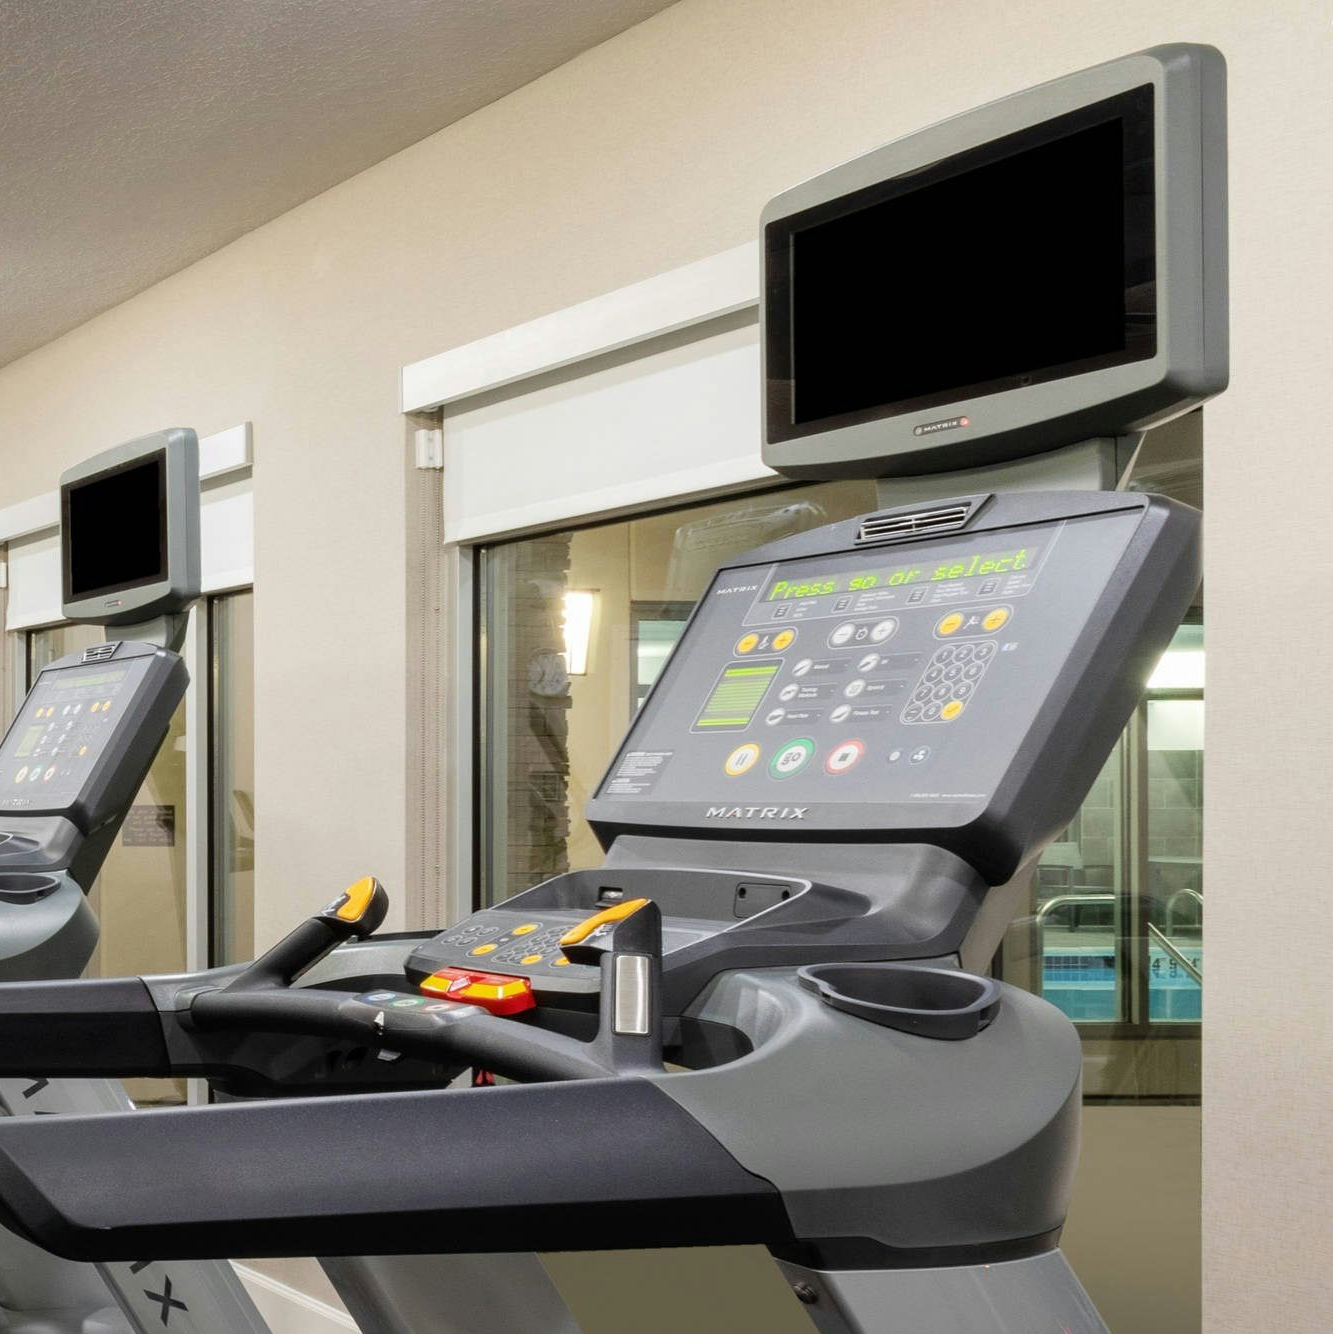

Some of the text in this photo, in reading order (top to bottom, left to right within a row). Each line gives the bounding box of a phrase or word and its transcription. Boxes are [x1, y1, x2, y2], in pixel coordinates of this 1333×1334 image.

[769, 549, 1028, 600] Press go or select
[717, 585, 758, 595] MATRIX
[781, 752, 801, 765] go
[705, 806, 809, 819] MATRIX
